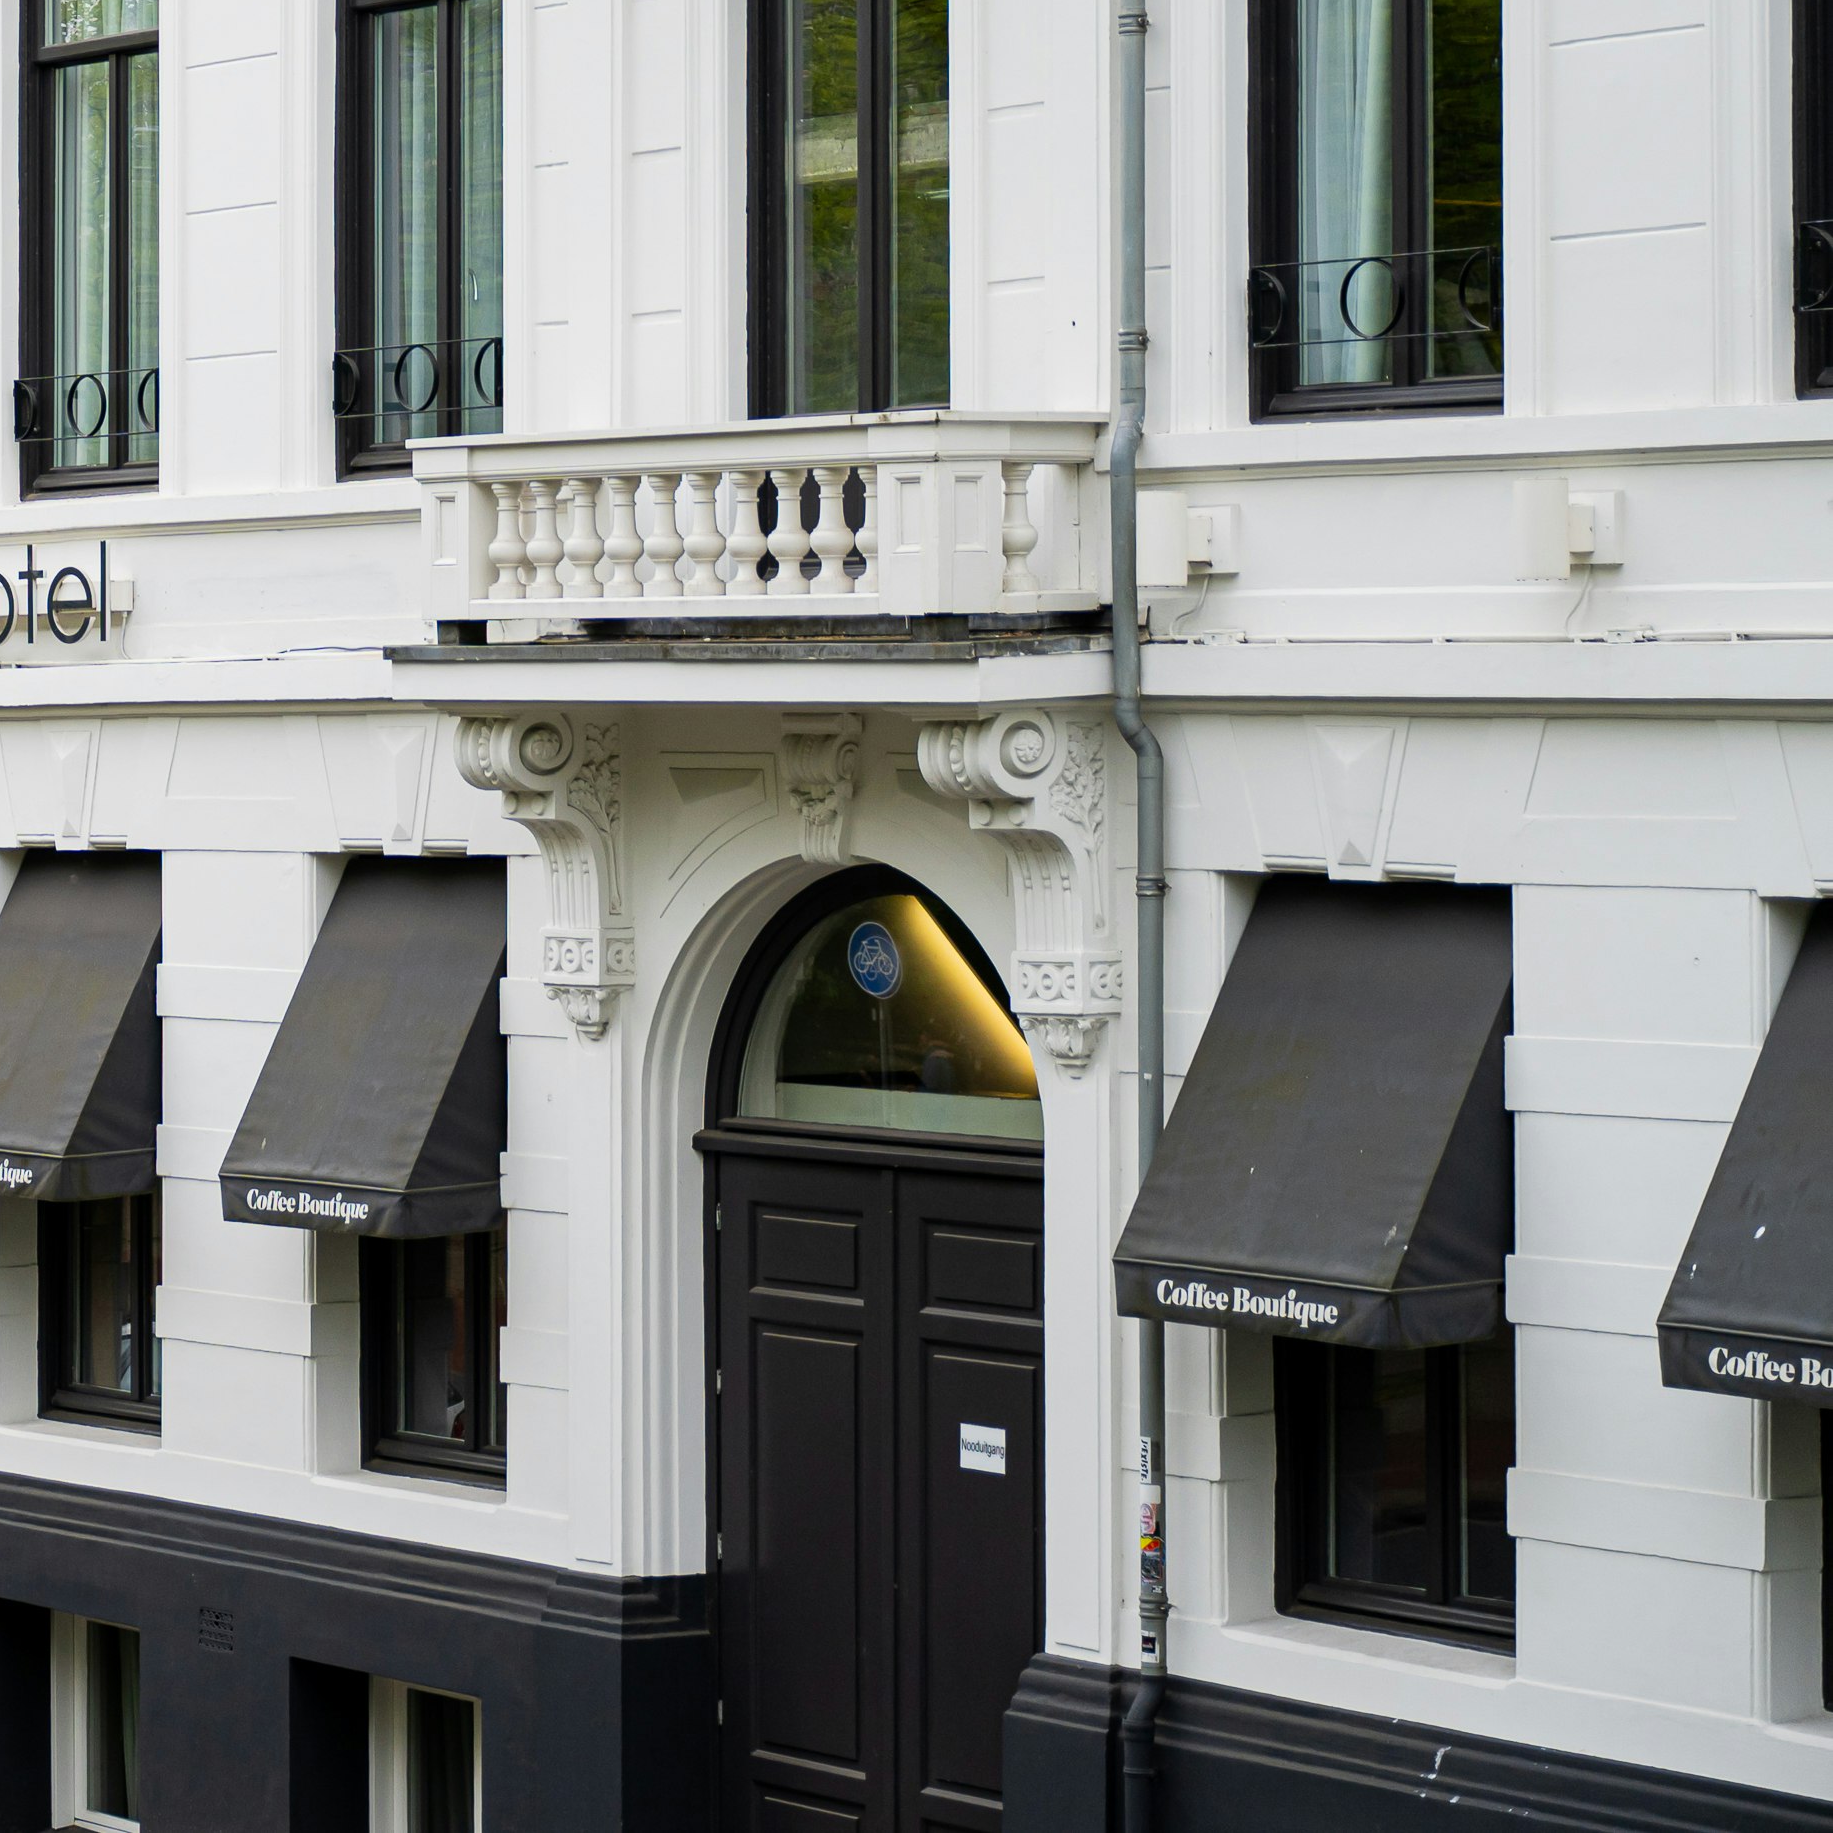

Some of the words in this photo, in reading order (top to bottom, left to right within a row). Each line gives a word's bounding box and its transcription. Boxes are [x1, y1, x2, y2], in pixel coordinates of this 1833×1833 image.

[246, 1188, 296, 1213] Coffee
[297, 1191, 369, 1224] Boutique
[1156, 1278, 1228, 1311] Coffee
[1232, 1286, 1339, 1329] Boutique
[1708, 1346, 1796, 1383] Coffee
[961, 1437, 1005, 1460] Nooduitgang
